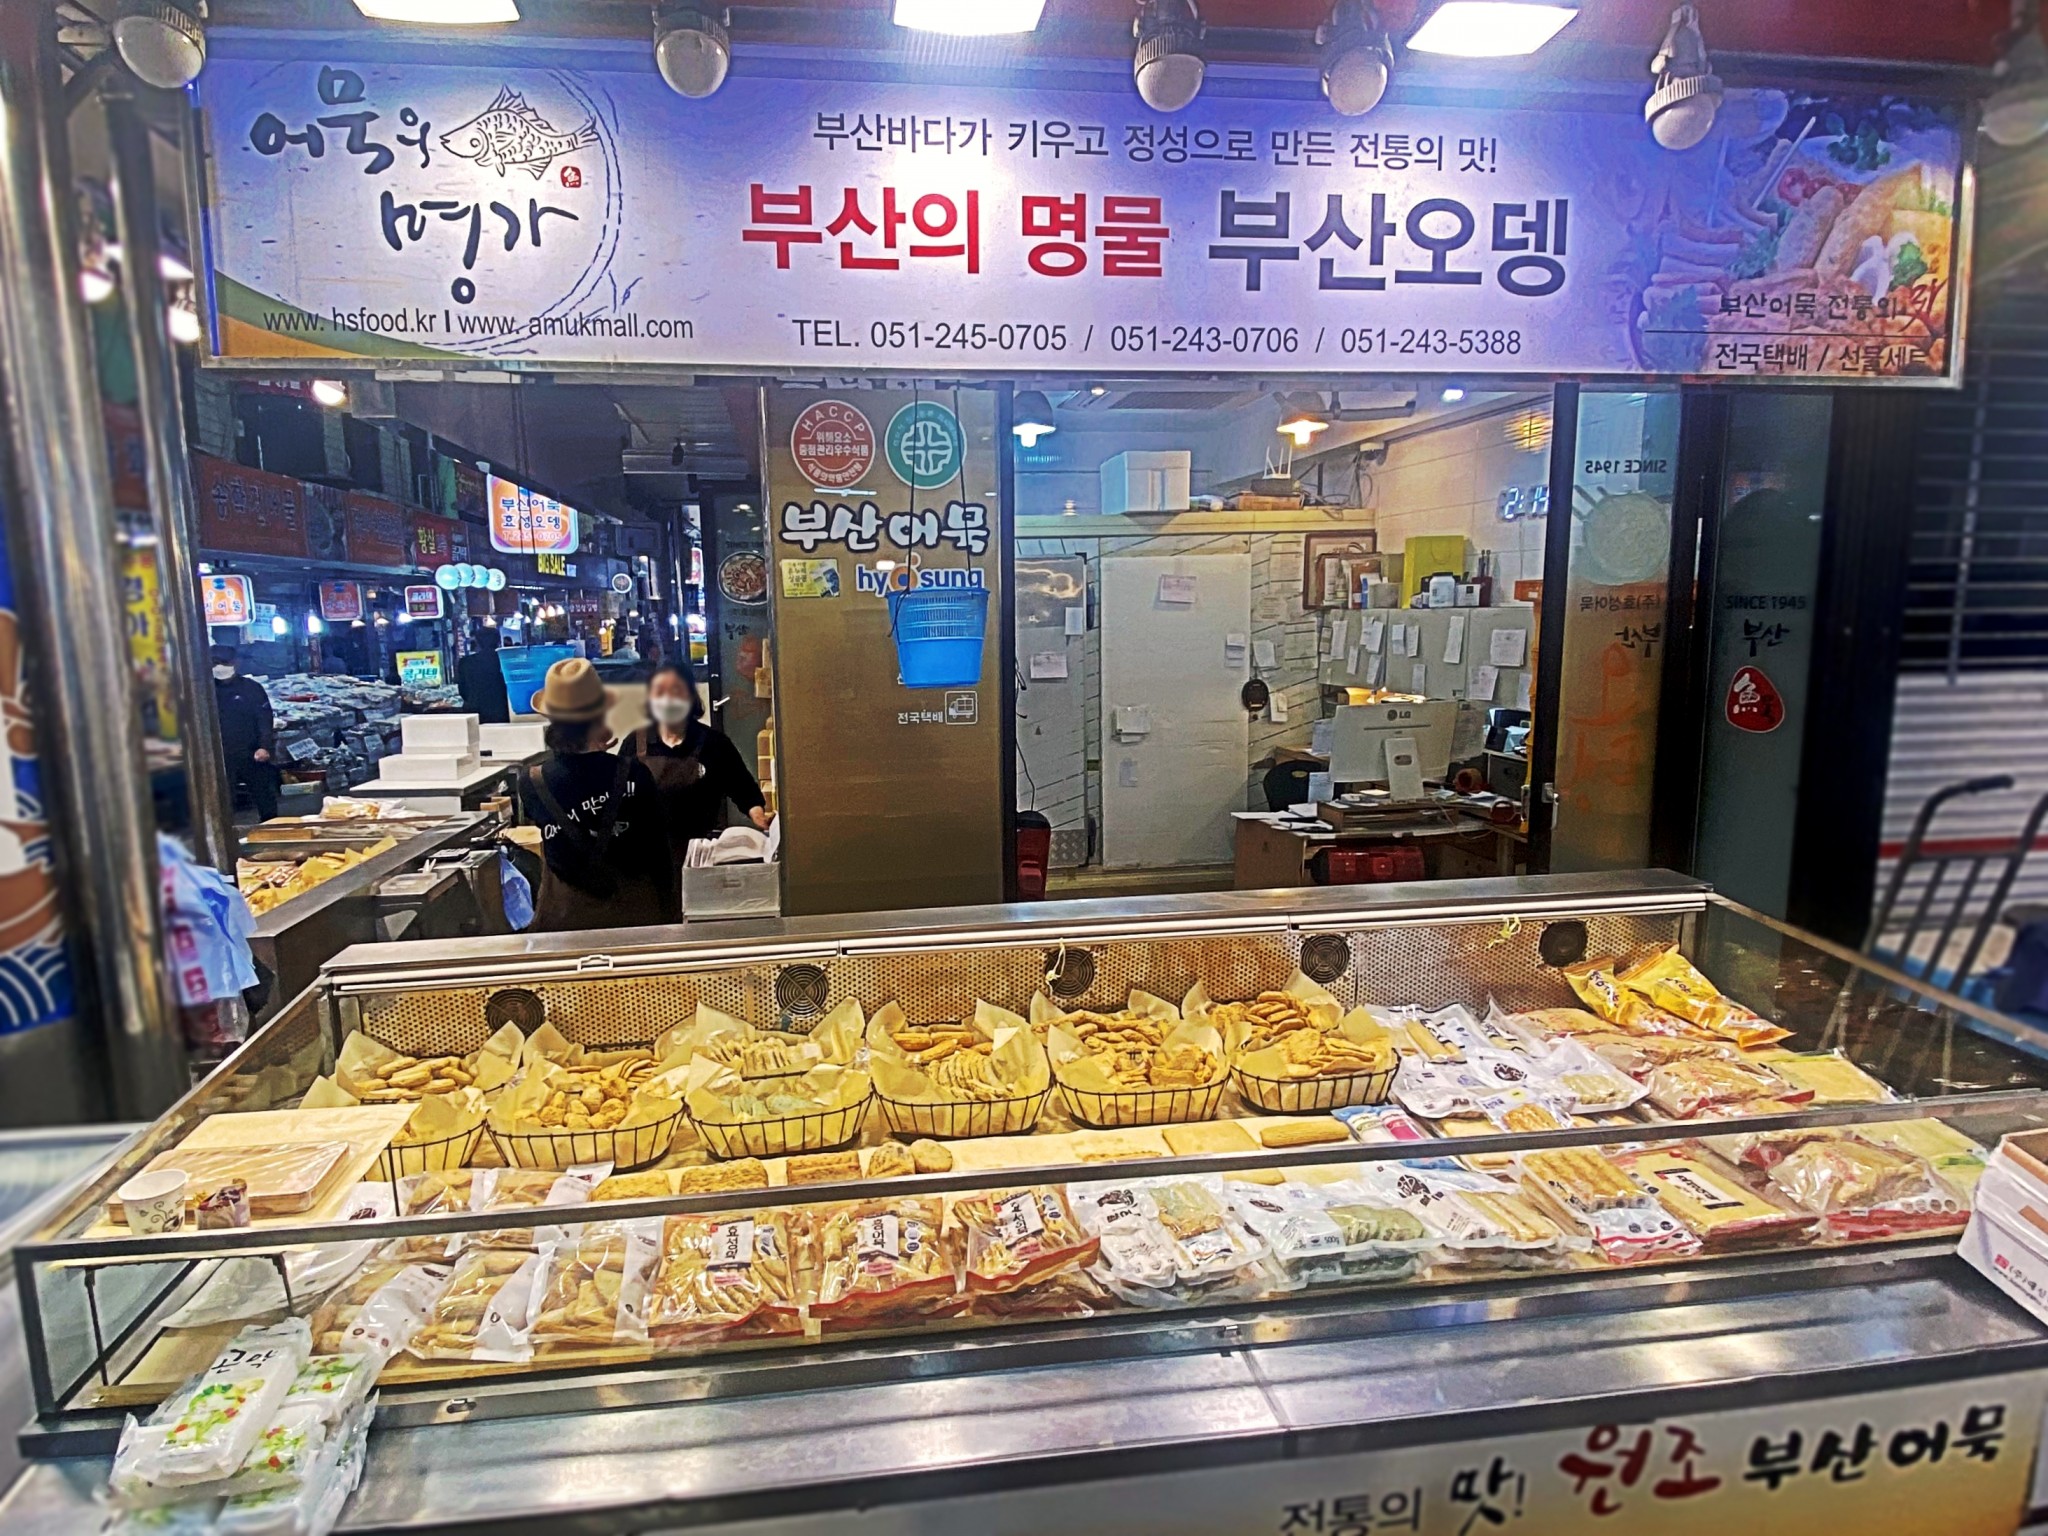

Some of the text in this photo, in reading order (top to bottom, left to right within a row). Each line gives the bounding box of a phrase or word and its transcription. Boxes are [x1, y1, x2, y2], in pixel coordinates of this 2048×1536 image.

[249, 65, 431, 175] 어묵의
[813, 111, 1498, 174] 부산바다가 키우고 정성으로 만든 전통의 맛!
[380, 190, 580, 304] 명가
[742, 183, 1570, 297] 부산의 명물 부산오뎅
[332, 305, 434, 333] hsfood.kr
[527, 311, 694, 339] amukmall.com
[1719, 292, 1817, 319] 부산어묵
[792, 319, 860, 347] TEL.
[870, 321, 1067, 352] 051-245-0705
[1110, 325, 1299, 353] 051-243-0706
[1340, 328, 1522, 356] 051-243-5388
[1715, 343, 1808, 371] 전국택배
[1839, 345, 1929, 374] 선물세트
[802, 405, 866, 432] HACCP
[816, 431, 851, 444] 위해요소
[780, 499, 990, 556] 부산어묵
[1726, 594, 1807, 610] SINCE 1945
[1743, 619, 1790, 658] 부산
[897, 708, 944, 725] 전국택배
[1398, 710, 1412, 719] LG
[1450, 1456, 1526, 1536] 맛!
[1558, 1423, 1722, 1516] 원조
[1742, 1404, 2006, 1490] 부산어묵
